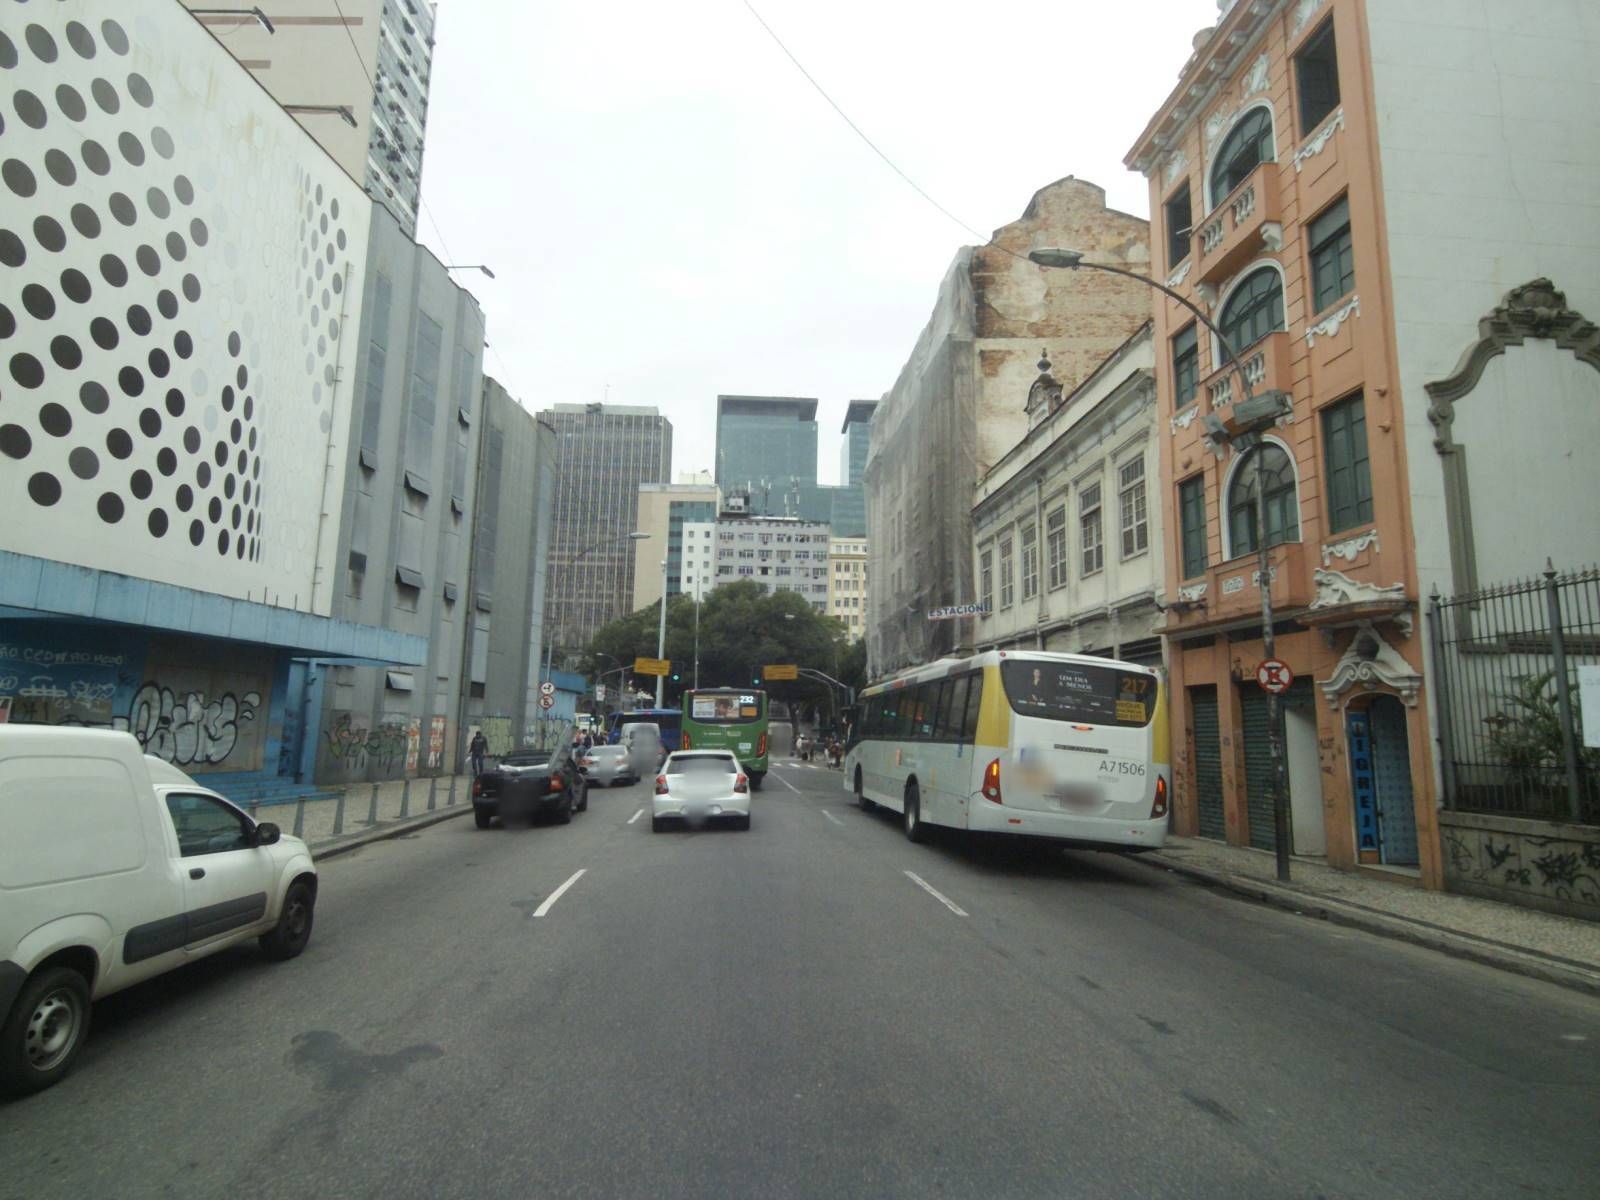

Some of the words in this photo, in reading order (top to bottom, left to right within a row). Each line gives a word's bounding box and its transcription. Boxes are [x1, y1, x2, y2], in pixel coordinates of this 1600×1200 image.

[1121, 676, 1148, 694] 217
[1098, 759, 1145, 777] A71506
[1355, 739, 1375, 848] IGREJA
